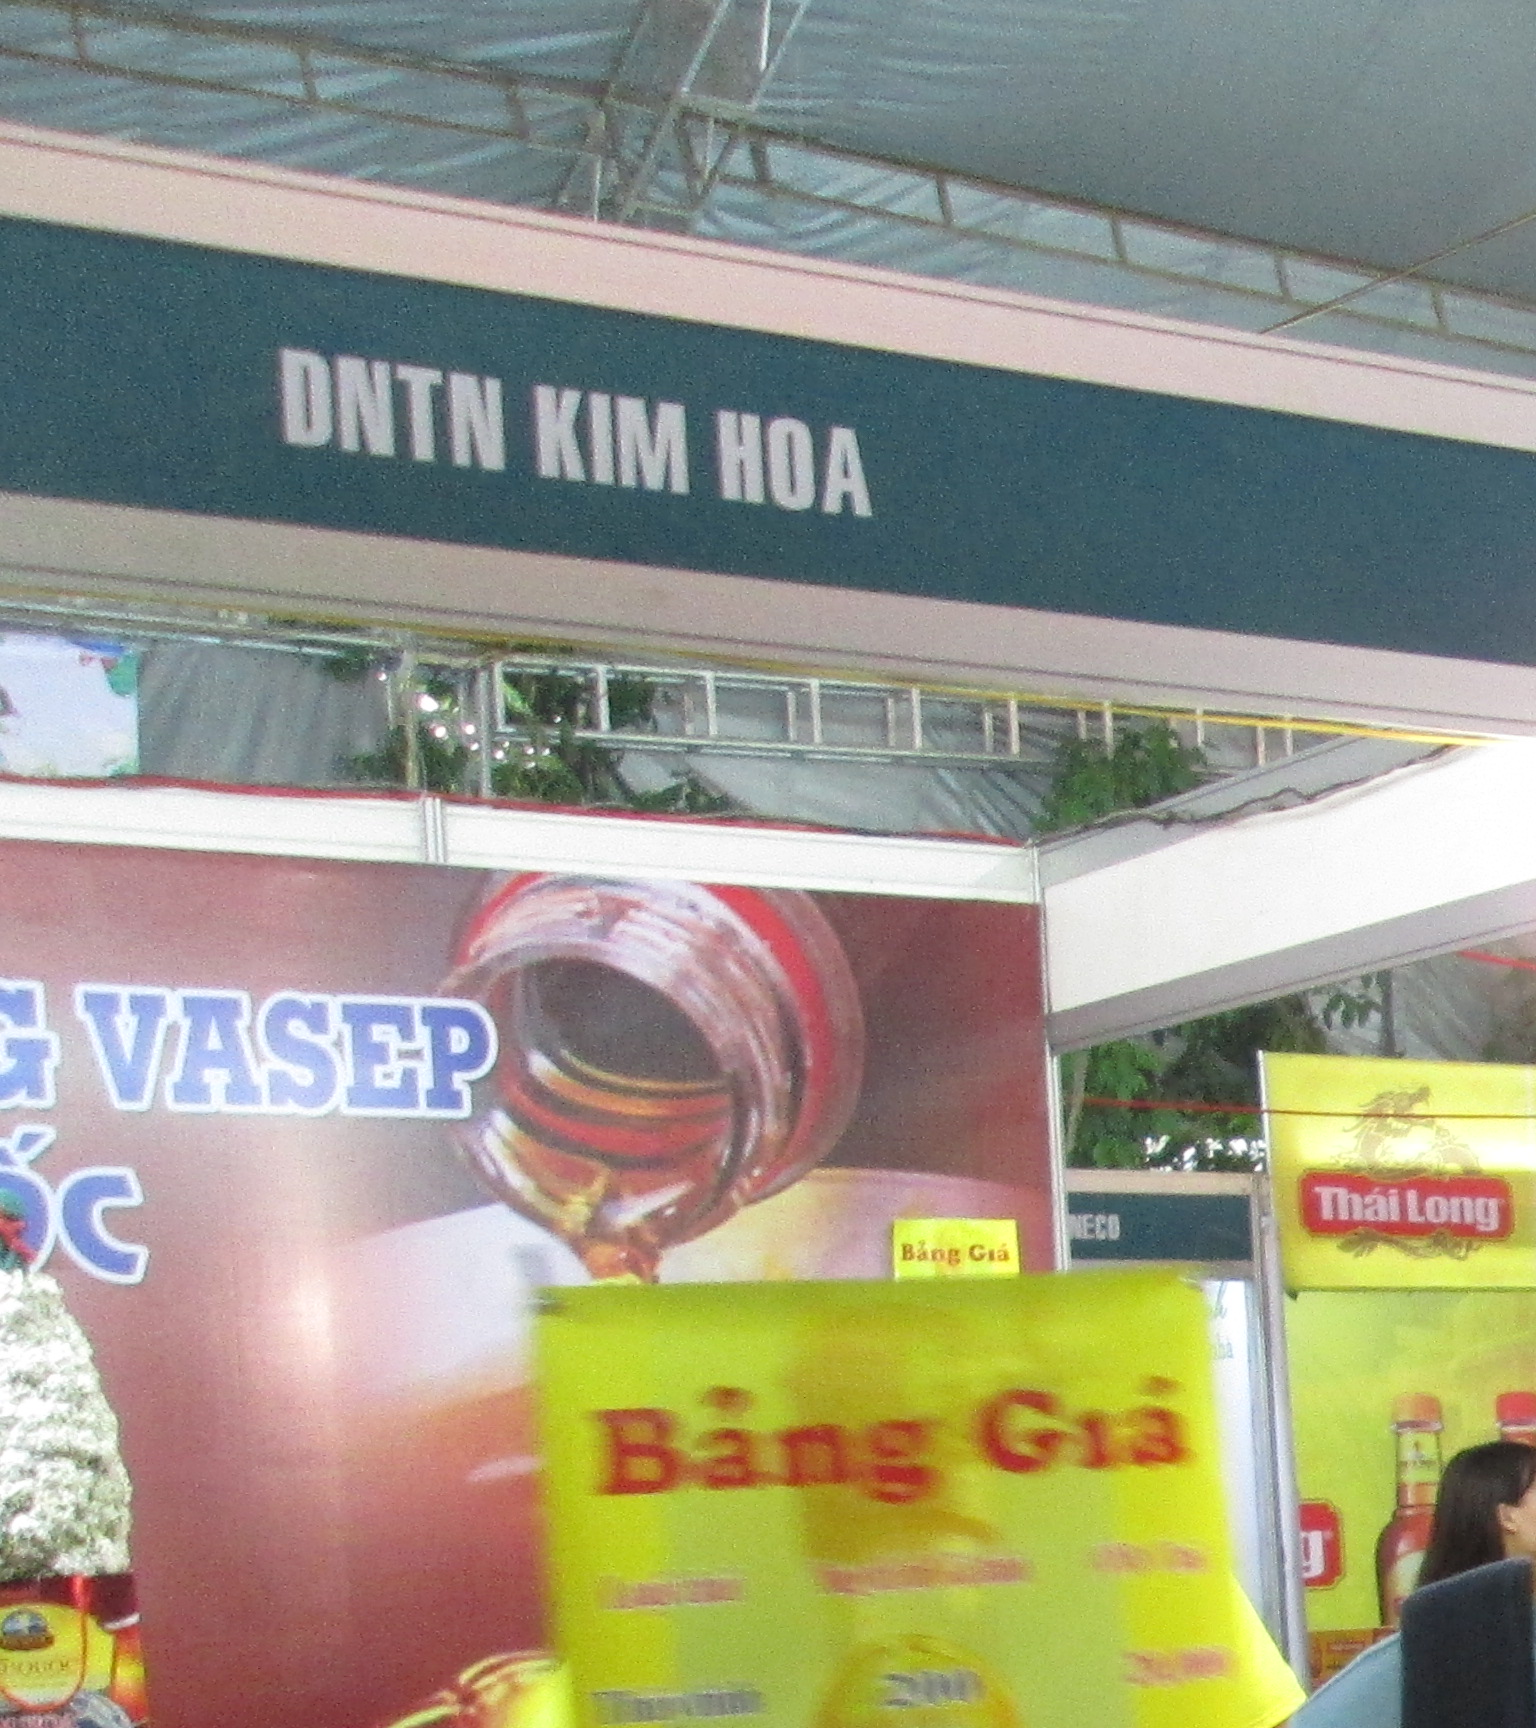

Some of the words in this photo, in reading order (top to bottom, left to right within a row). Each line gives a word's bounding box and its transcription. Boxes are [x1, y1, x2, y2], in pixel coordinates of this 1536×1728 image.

[279, 346, 506, 473] DNTN
[533, 382, 691, 496] KIM
[716, 408, 874, 519] HOA
[75, 983, 498, 1118] VASEP
[901, 1240, 960, 1266] Bảng
[968, 1242, 1010, 1263] Giá
[1313, 1185, 1401, 1225] Thái
[1407, 1191, 1502, 1232] Long
